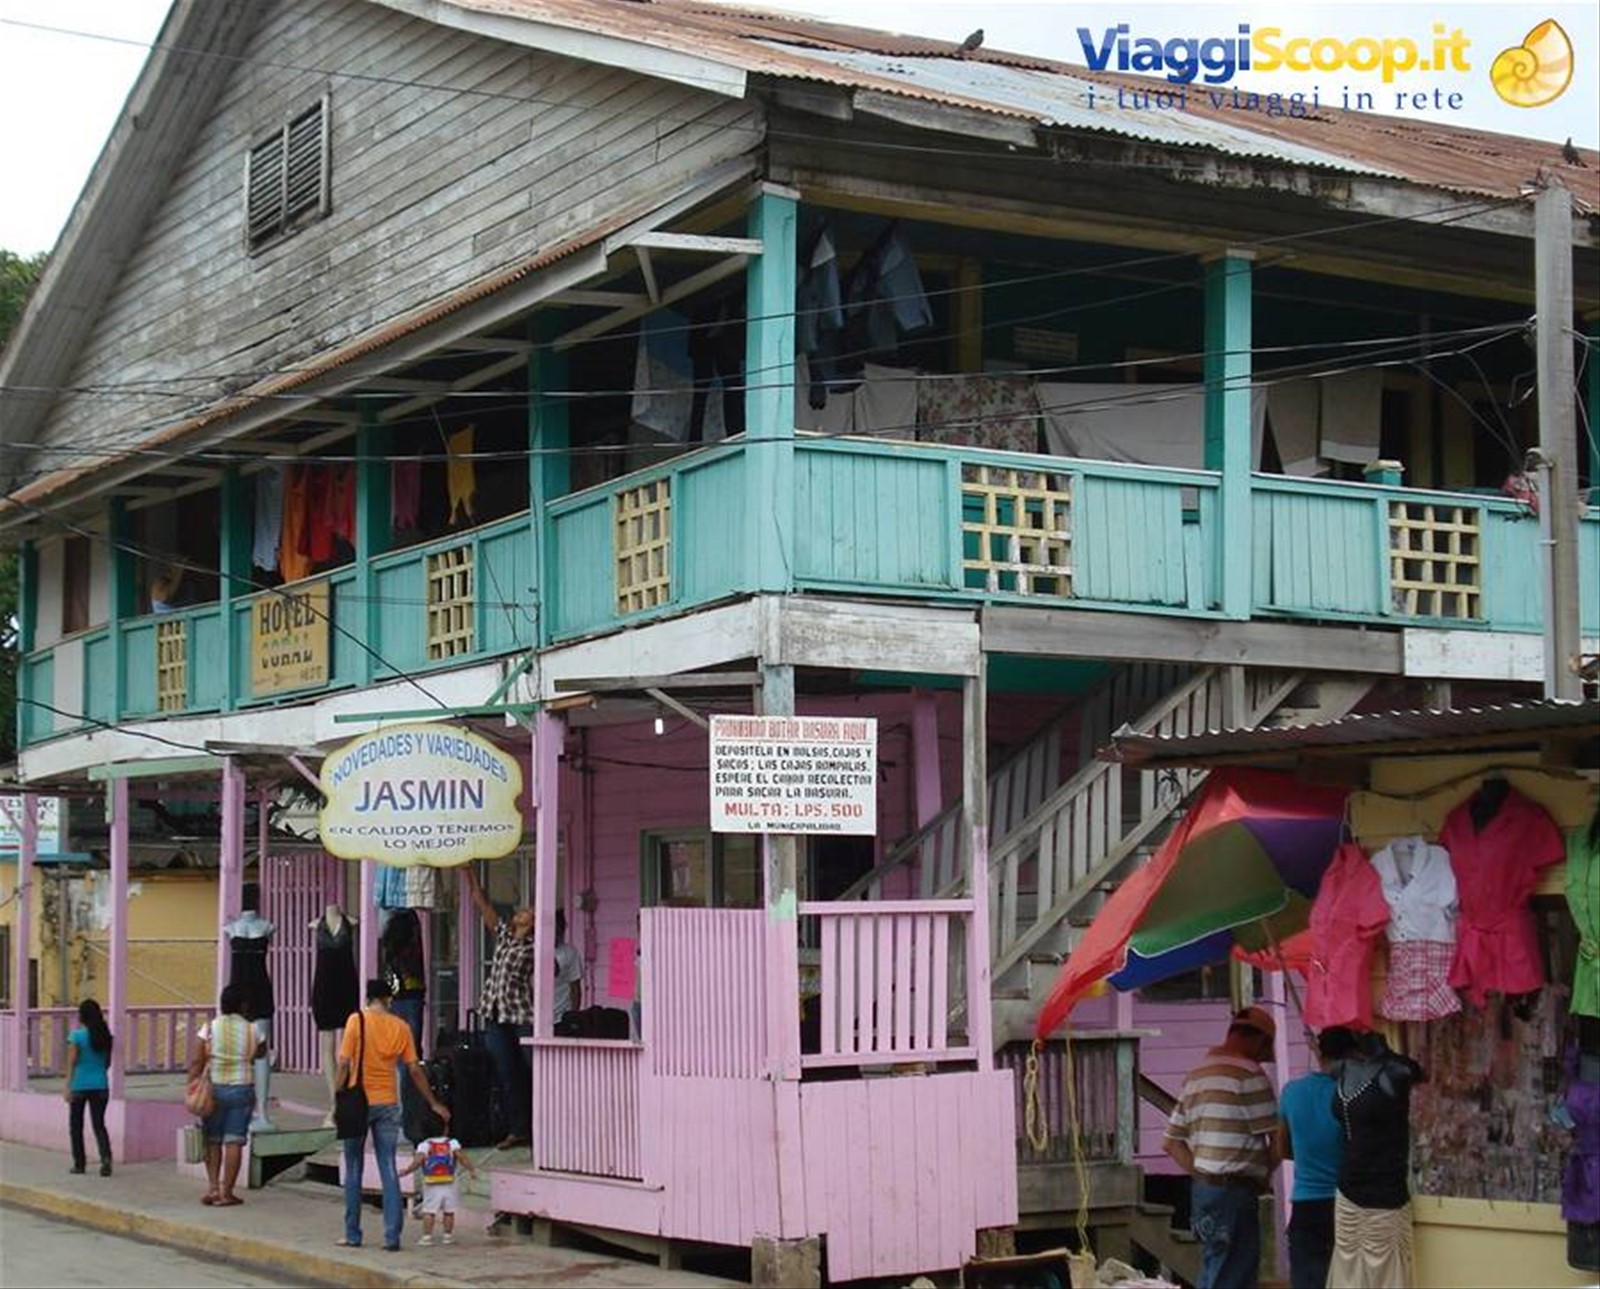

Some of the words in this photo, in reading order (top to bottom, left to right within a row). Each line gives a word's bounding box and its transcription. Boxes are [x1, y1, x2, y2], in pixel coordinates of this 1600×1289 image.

[260, 592, 316, 636] HOTEL
[768, 720, 799, 739] BOTAR
[803, 721, 839, 740] BASURA
[414, 733, 425, 754] Y
[427, 733, 508, 783] VARIEDADES
[715, 745, 773, 757] DEPOSITELA
[778, 746, 790, 757] EN
[865, 748, 871, 758] Y
[758, 760, 777, 770] LAS
[781, 760, 812, 771] CAJAS
[715, 773, 751, 784] ESPERE
[756, 773, 768, 784] EL
[808, 774, 872, 785] RECOLECTOR
[354, 778, 484, 812] JASMIN
[715, 786, 743, 797] PARA
[747, 787, 782, 798] SACAR
[786, 787, 800, 798] LA
[724, 802, 789, 817] MULTA:
[329, 826, 352, 835] EN
[357, 825, 432, 835] CALIDAD
[435, 823, 514, 835] TENEMOS
[748, 822, 761, 830] LA
[767, 822, 841, 831] MUNICIPALIDAD
[383, 839, 407, 849] LO
[410, 837, 466, 850] MEJOR
